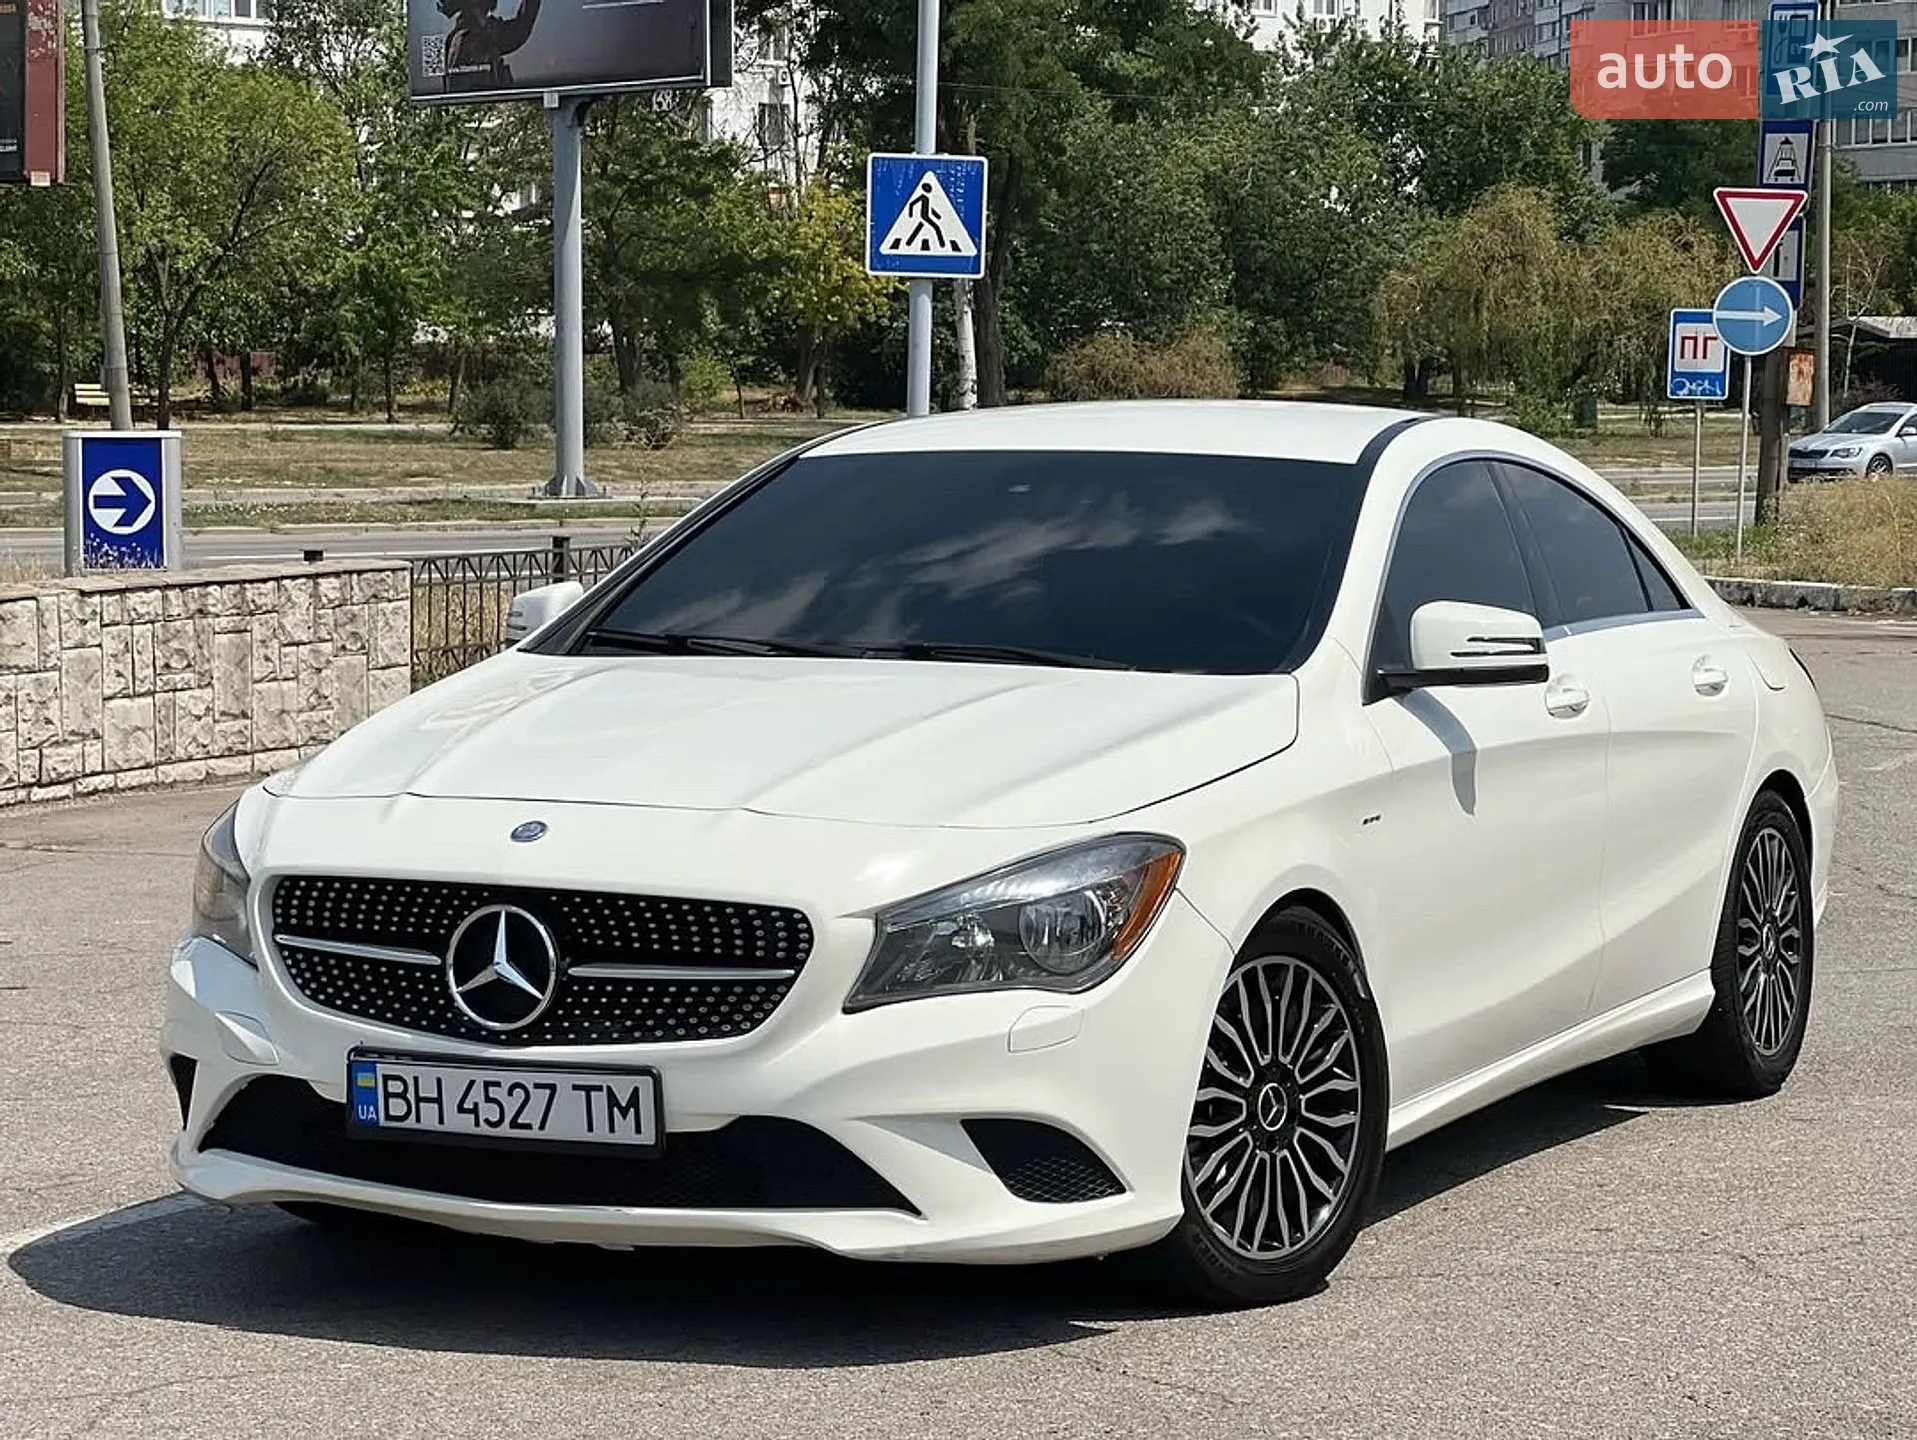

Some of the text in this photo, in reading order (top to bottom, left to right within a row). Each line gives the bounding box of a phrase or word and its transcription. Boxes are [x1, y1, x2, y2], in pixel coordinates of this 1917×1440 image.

[1680, 336, 1718, 359] ПГ
[357, 1104, 377, 1121] UA
[381, 1073, 642, 1135] BH 4527 TM
